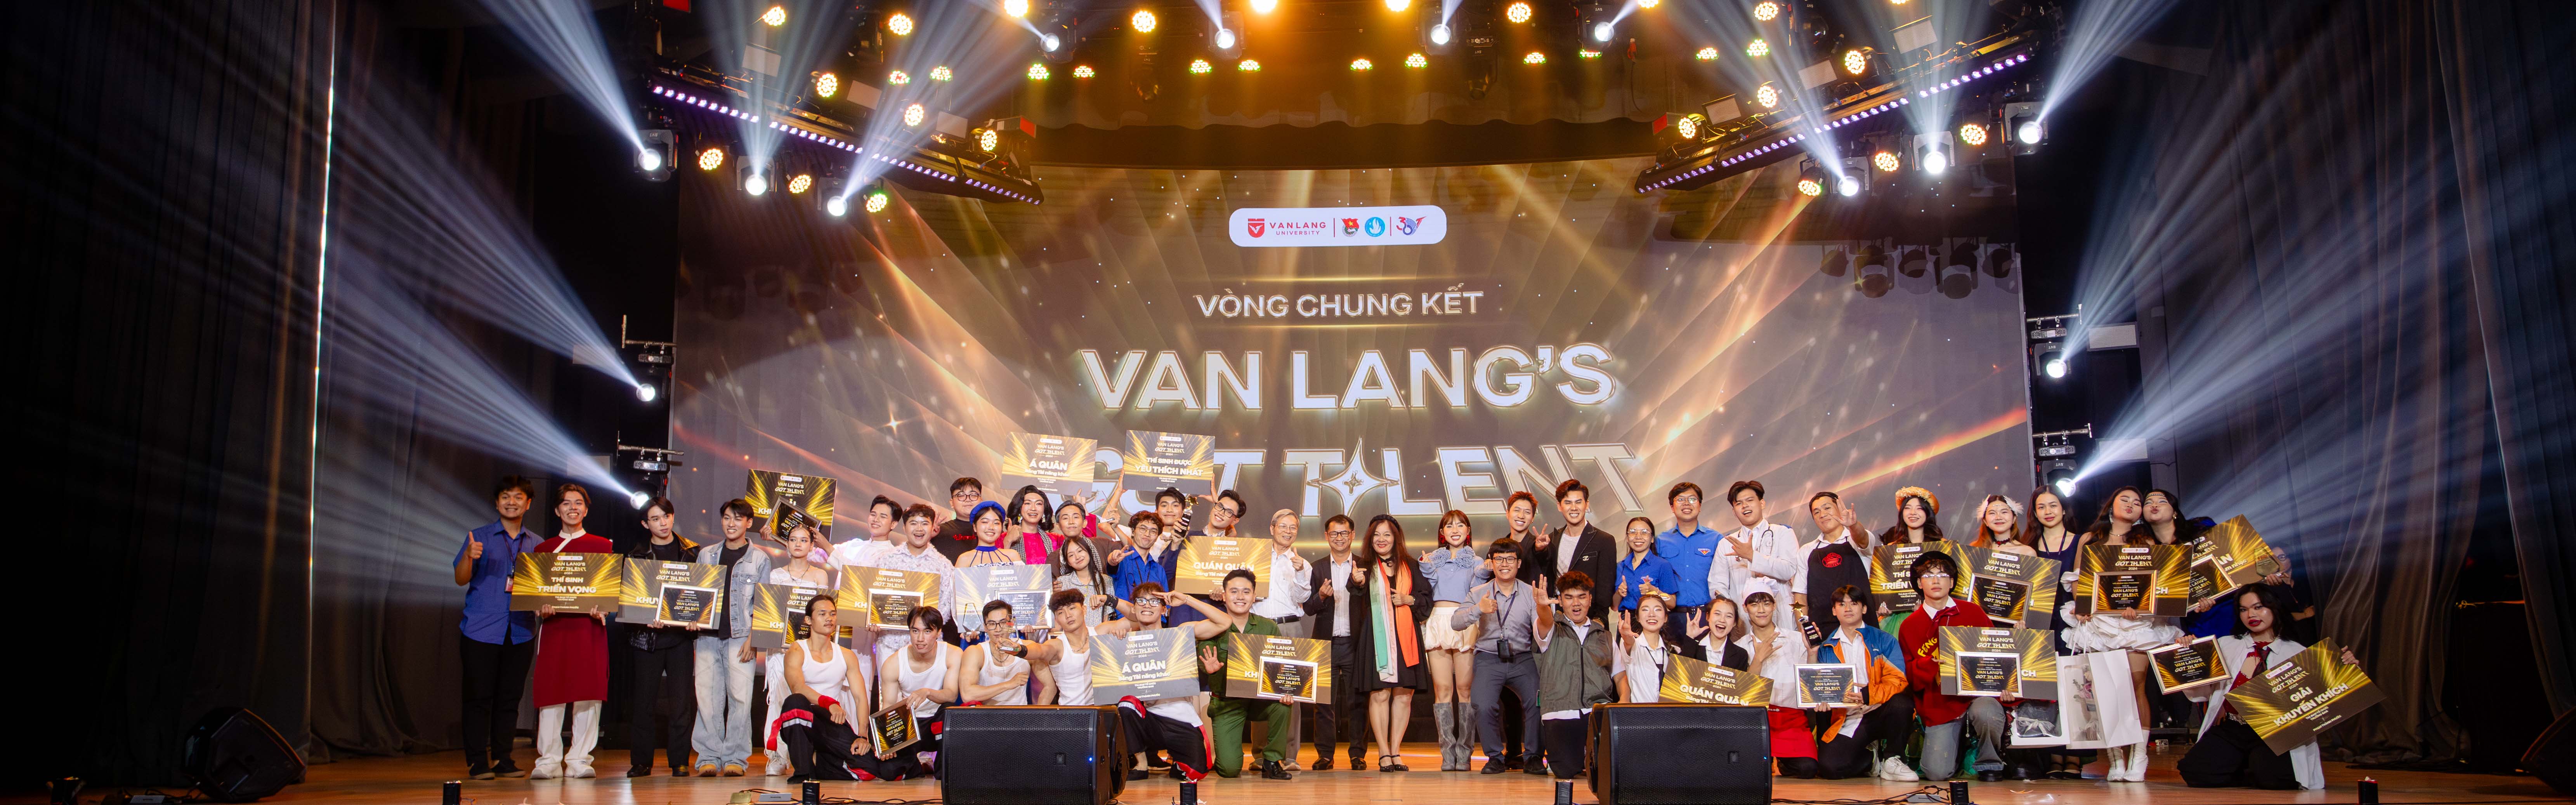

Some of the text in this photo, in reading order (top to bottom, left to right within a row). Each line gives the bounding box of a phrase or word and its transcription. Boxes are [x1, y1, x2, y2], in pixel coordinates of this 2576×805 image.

[1195, 283, 1484, 318] VÒNG CHUNG KẾT
[1079, 342, 1618, 411] VAN LANG'S
[1029, 458, 1068, 470] Á QUÂN
[1135, 465, 1204, 476] YÊU THÍCH NHẤT
[1193, 560, 1223, 570] QUÁN
[537, 583, 566, 593] TRIỂN
[1881, 579, 1908, 590] TRIỂN
[1122, 659, 1166, 673] Á QUÂN
[1716, 675, 1736, 683] LANG'S
[2268, 666, 2302, 686] VAN LANG'S
[1680, 685, 1714, 699] QUÁN
[2272, 683, 2286, 693] GOT
[2290, 686, 2314, 702] GIẢI
[2273, 683, 2349, 727] KHUYẾN KHÍCH
